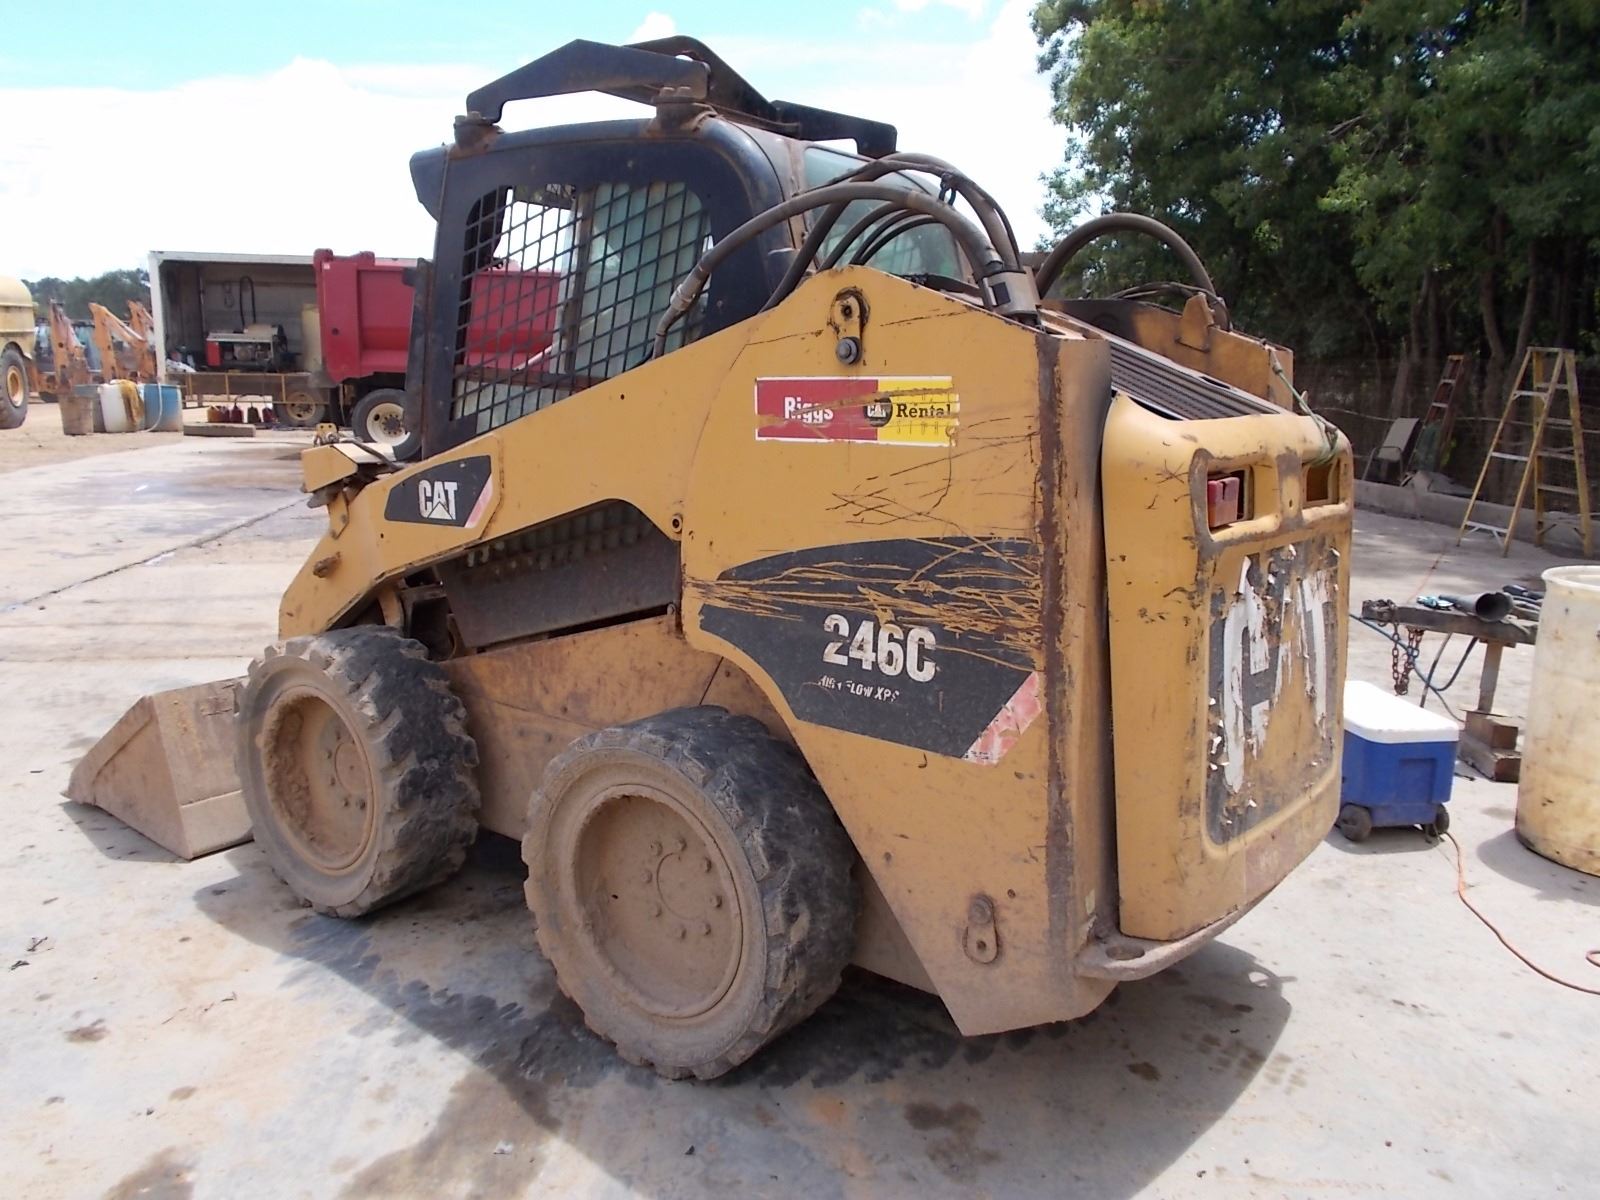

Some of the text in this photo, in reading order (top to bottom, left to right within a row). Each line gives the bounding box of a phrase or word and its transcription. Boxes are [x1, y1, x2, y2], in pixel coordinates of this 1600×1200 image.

[784, 396, 833, 424] Riggs
[896, 402, 951, 418] Rental
[418, 479, 458, 520] CAT
[822, 613, 936, 682] 246C
